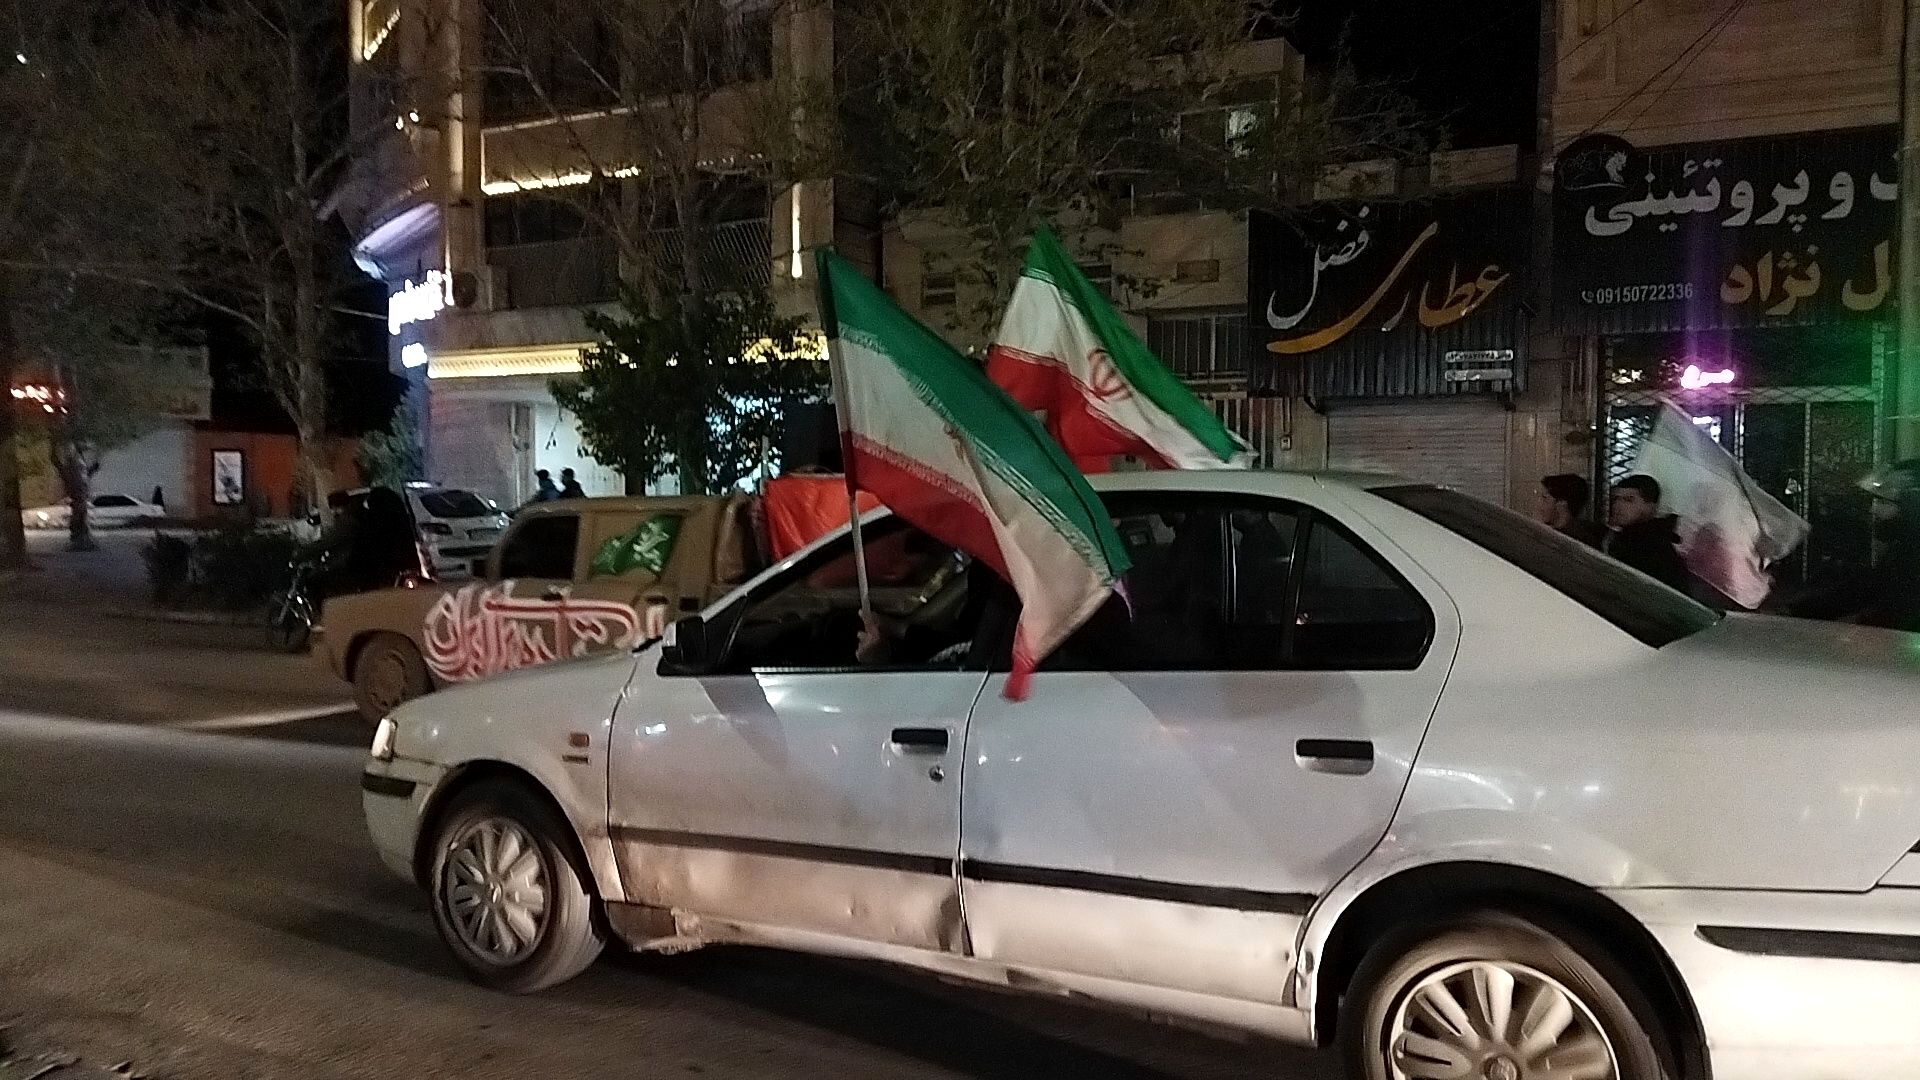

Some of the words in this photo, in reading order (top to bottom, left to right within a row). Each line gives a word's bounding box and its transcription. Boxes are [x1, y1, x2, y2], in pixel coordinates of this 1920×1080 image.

[1585, 158, 1810, 237] پروتئینی
[1821, 171, 1855, 220] و
[1266, 205, 1370, 330] فضل
[1266, 221, 1510, 354] عطاری
[1596, 282, 1694, 304] 09150722336
[1719, 244, 1820, 316] نژاد
